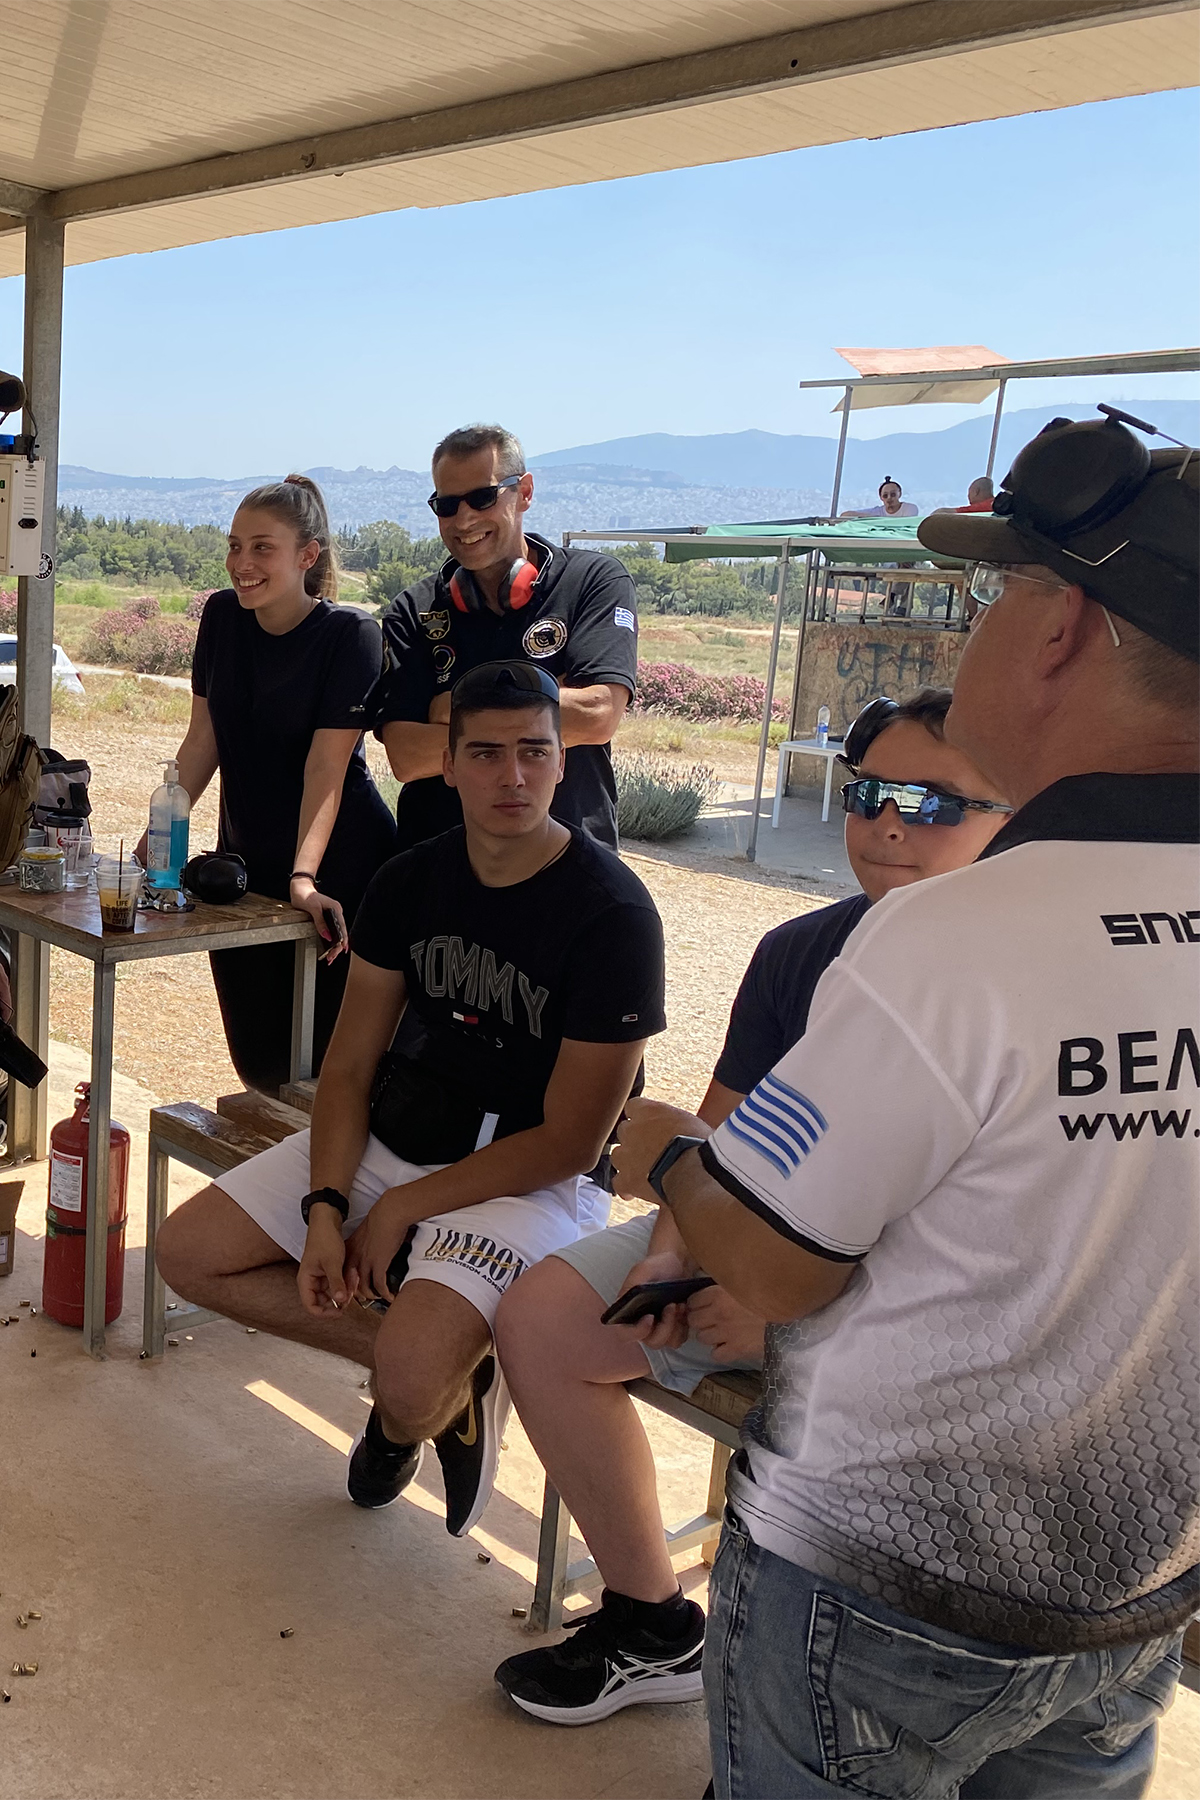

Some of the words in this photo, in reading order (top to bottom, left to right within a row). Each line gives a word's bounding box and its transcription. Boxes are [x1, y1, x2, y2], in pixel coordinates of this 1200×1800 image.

[410, 935, 550, 1039] TOMMY
[1058, 1108, 1200, 1142] www.
[446, 1257, 481, 1276] DIVISION
